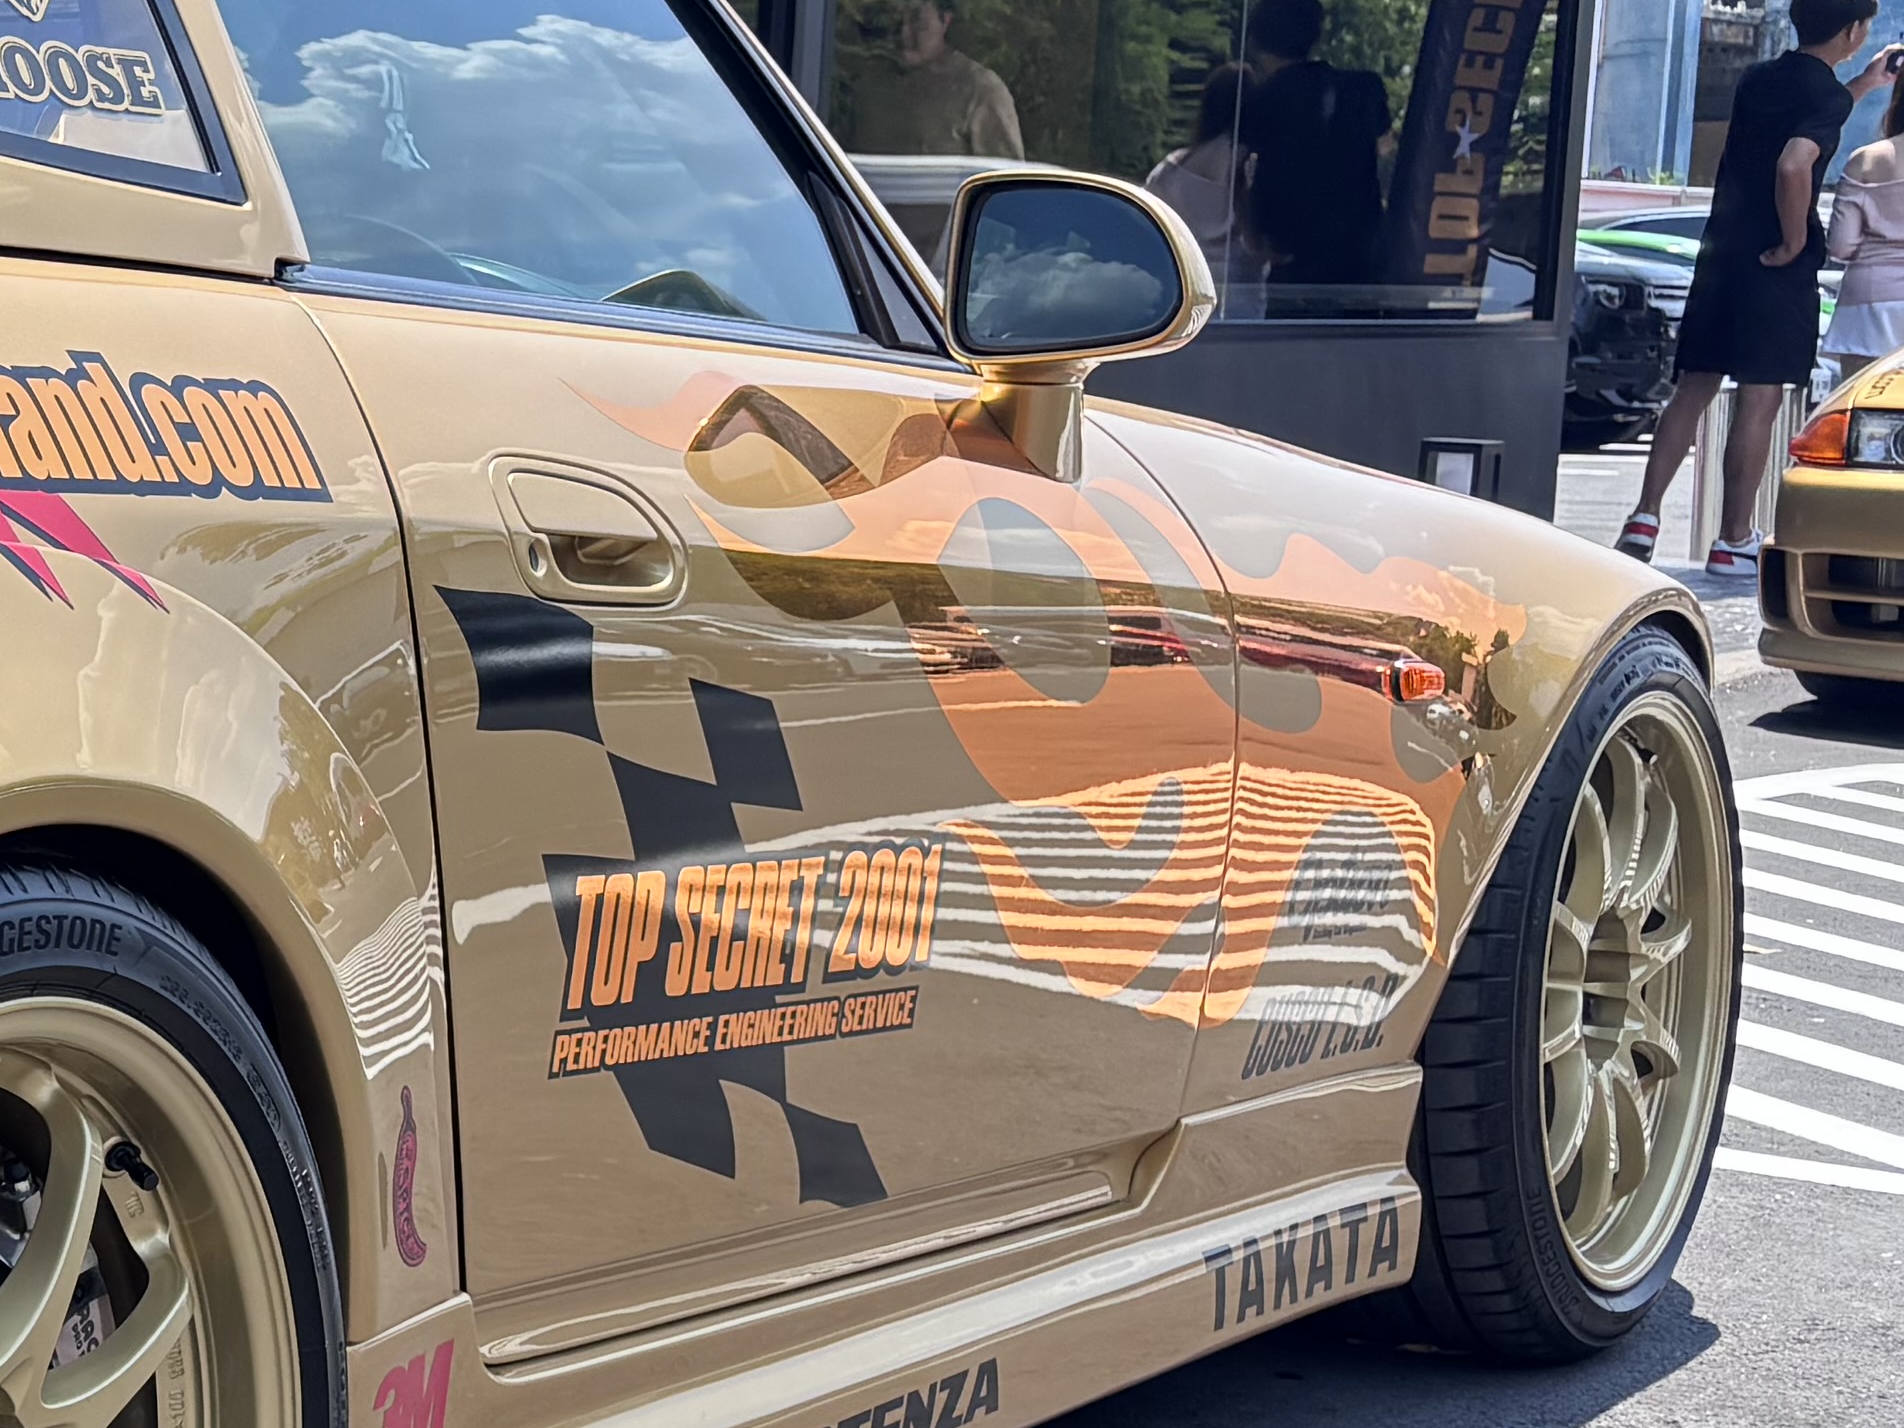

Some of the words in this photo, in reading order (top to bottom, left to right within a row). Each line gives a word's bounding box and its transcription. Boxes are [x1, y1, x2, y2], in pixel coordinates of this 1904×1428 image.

[566, 869, 666, 1010] TOP
[664, 856, 826, 998] SECRET
[828, 843, 943, 973] 2001
[552, 1015, 713, 1073] PERFORMANCE
[714, 1001, 840, 1052] ENGINEERING
[840, 989, 917, 1034] SERVICE
[1202, 1194, 1400, 1331] TAKATA
